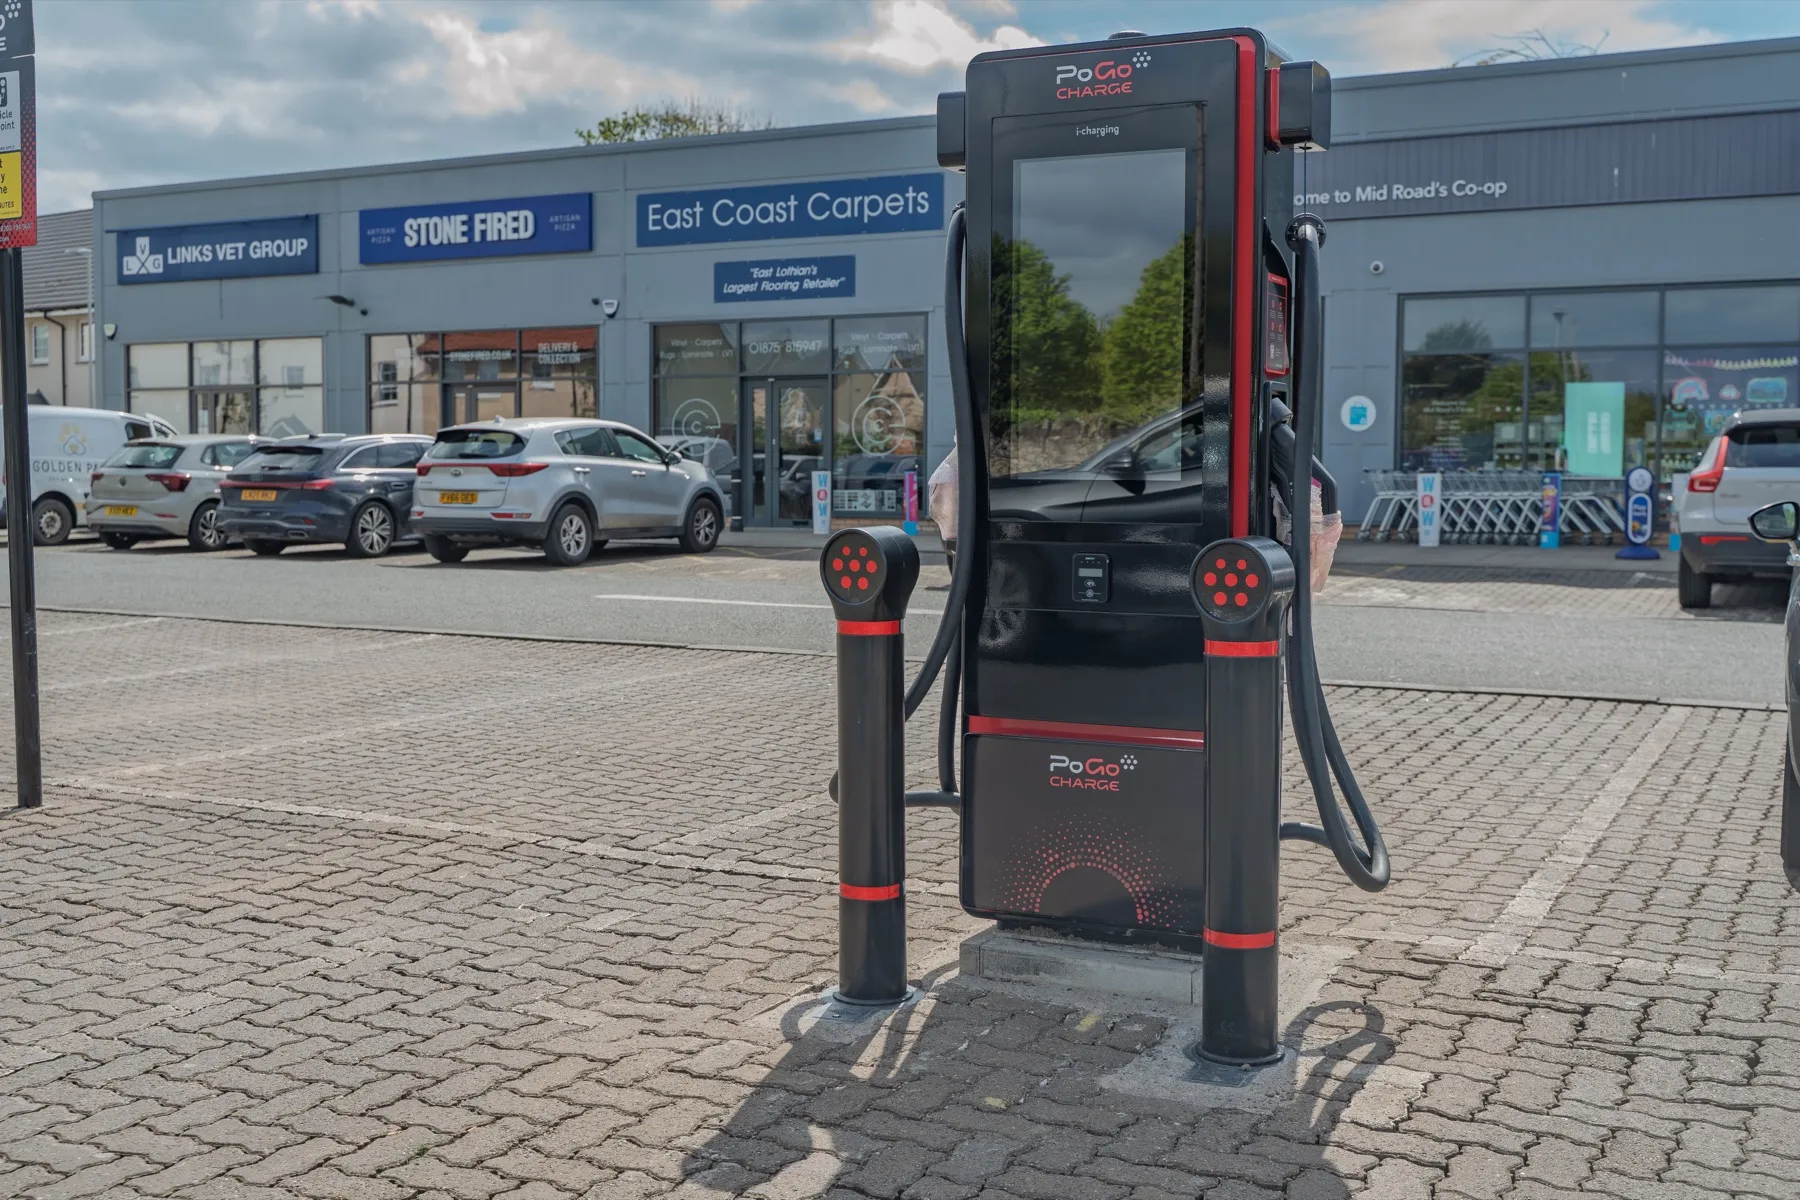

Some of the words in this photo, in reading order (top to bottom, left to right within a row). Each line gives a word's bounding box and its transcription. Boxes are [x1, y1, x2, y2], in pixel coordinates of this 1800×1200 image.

[1056, 61, 1133, 84] PoGo
[1056, 82, 1133, 99] CHARGE
[1076, 125, 1120, 137] i-charging
[1334, 190, 1351, 203] to
[1355, 184, 1388, 202] Mid
[1392, 181, 1448, 199] Road's
[1452, 179, 1507, 197] Co-op
[648, 201, 704, 231] East
[712, 194, 798, 227] Coast
[807, 186, 930, 223] Carpets
[549, 214, 581, 222] ARTISAN
[366, 227, 397, 235] ARTISAN
[404, 215, 469, 247] STONE
[474, 210, 535, 242] FIRED
[554, 223, 576, 231] PIZZA
[371, 236, 391, 244] PIZZA
[167, 244, 213, 264] LINKS
[216, 242, 246, 261] VET
[249, 238, 308, 259] GROUP
[750, 267, 773, 279] "East
[776, 265, 818, 277] Lothian's
[723, 281, 758, 294] Largest
[761, 280, 799, 292] Flooring
[802, 277, 846, 290] Retailer"
[538, 342, 572, 353] DELIVERY
[695, 338, 723, 347] Carpets
[538, 354, 581, 364] COLLECTION
[721, 349, 733, 358] LVT
[32, 460, 82, 472] GOLDEN
[1050, 755, 1120, 777] PoGo
[1049, 776, 1120, 791] CHARGE
